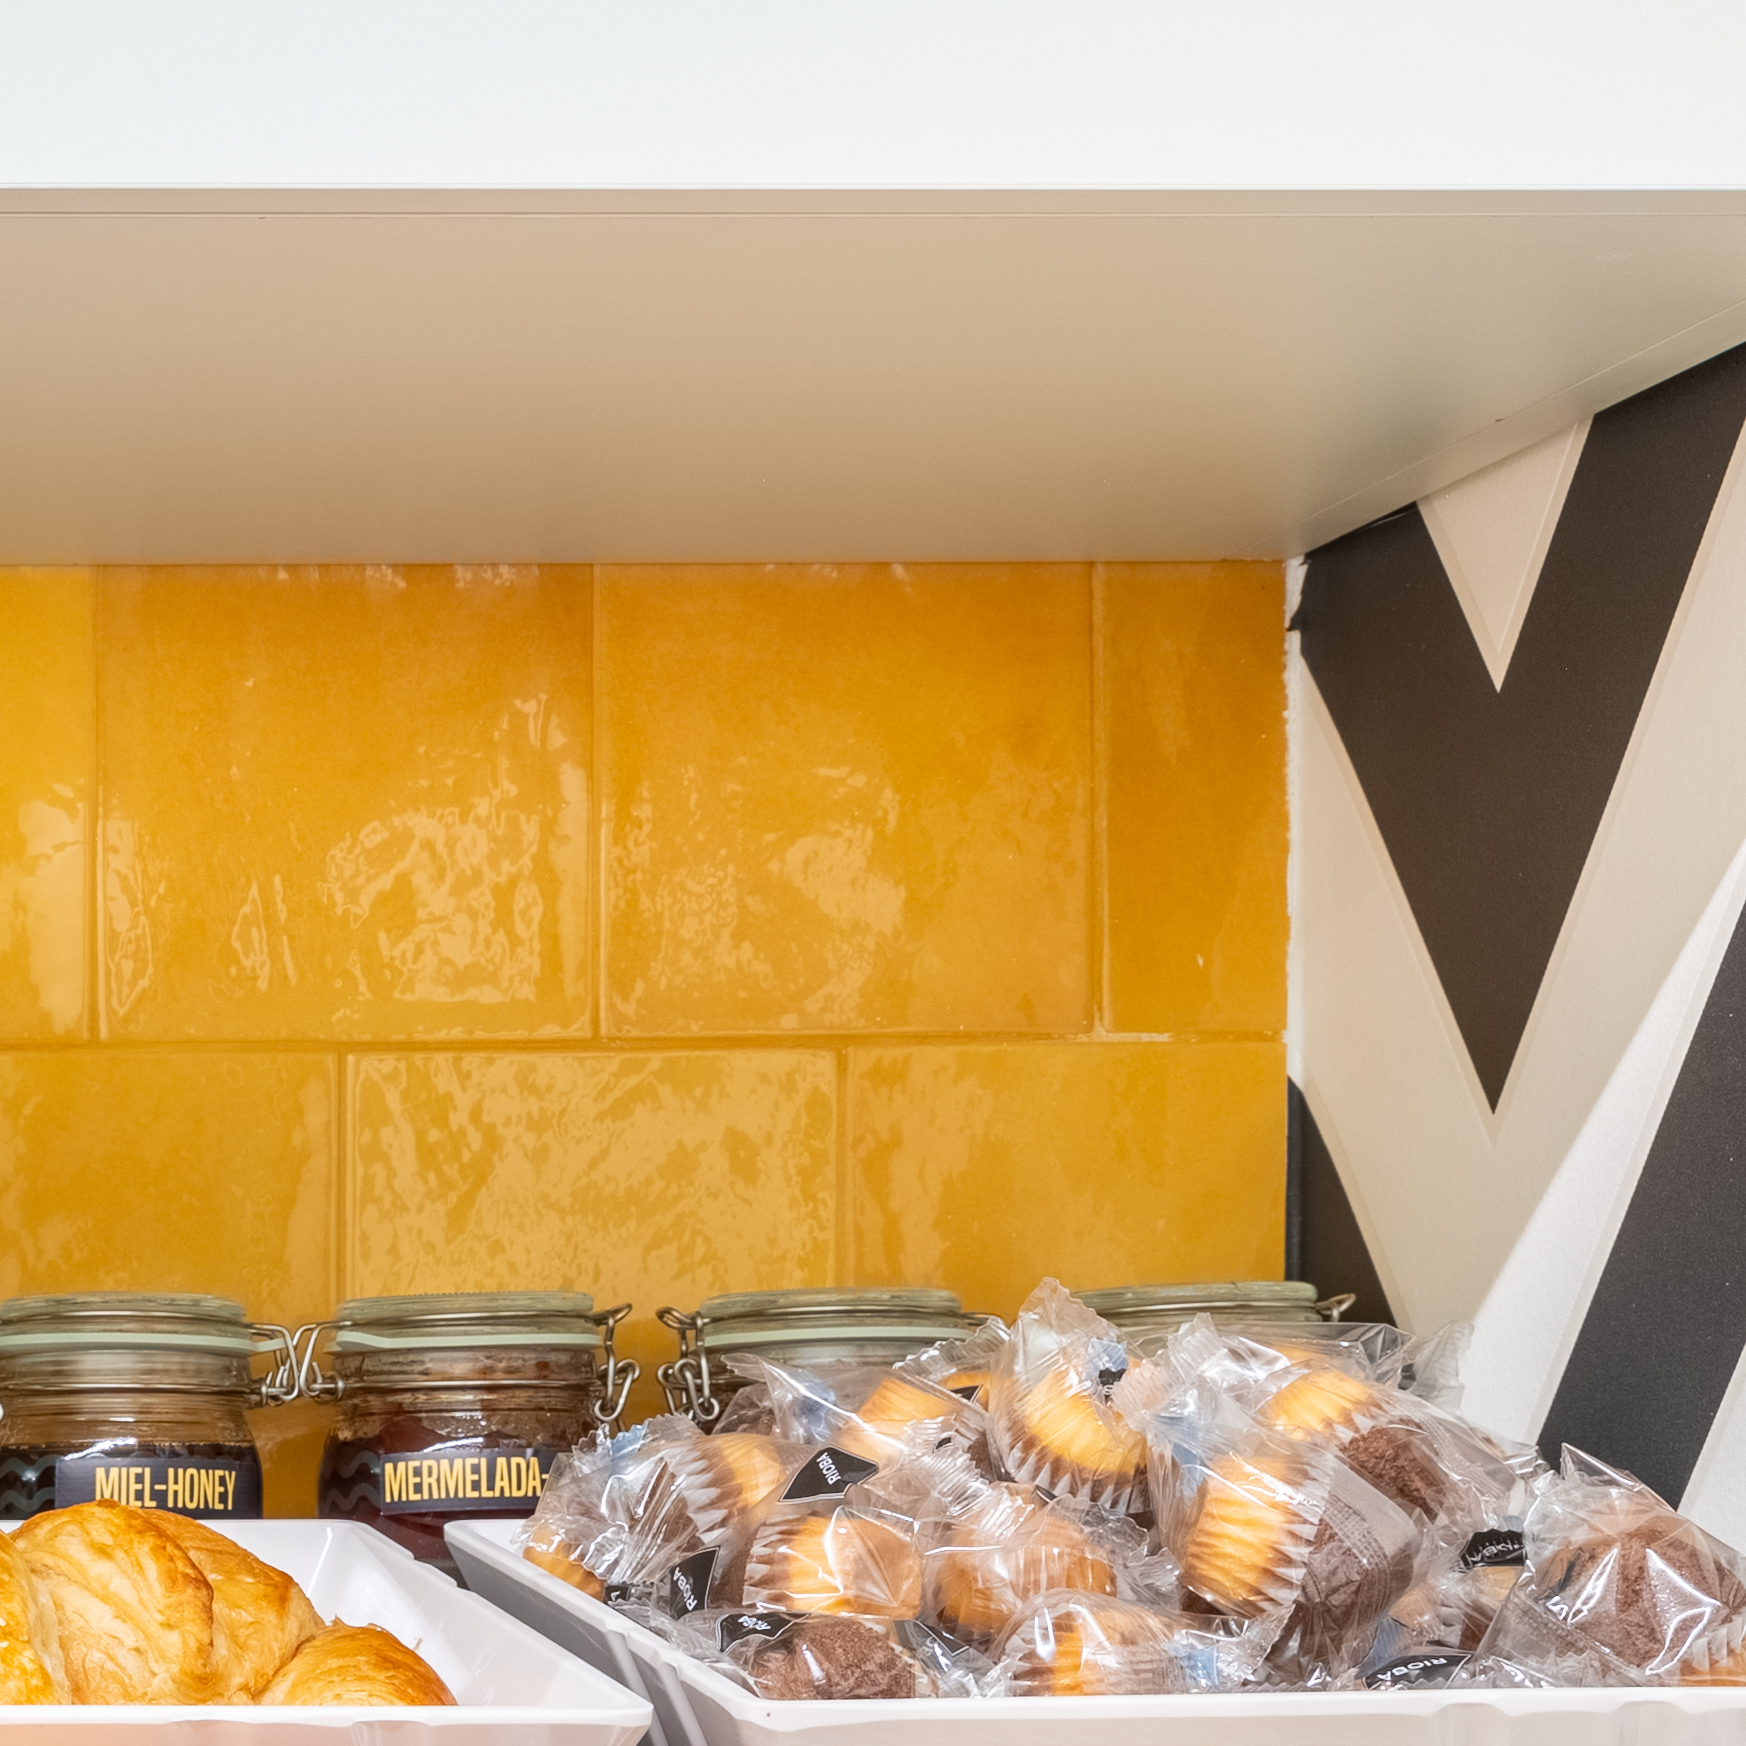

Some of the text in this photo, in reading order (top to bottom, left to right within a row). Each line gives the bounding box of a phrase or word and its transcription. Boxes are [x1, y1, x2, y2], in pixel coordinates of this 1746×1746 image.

[816, 1451, 842, 1485] RIOBA
[94, 1466, 237, 1511] MIEL-HONEY
[672, 1566, 698, 1612] RIOBA
[1376, 1657, 1448, 1681] RIOBA
